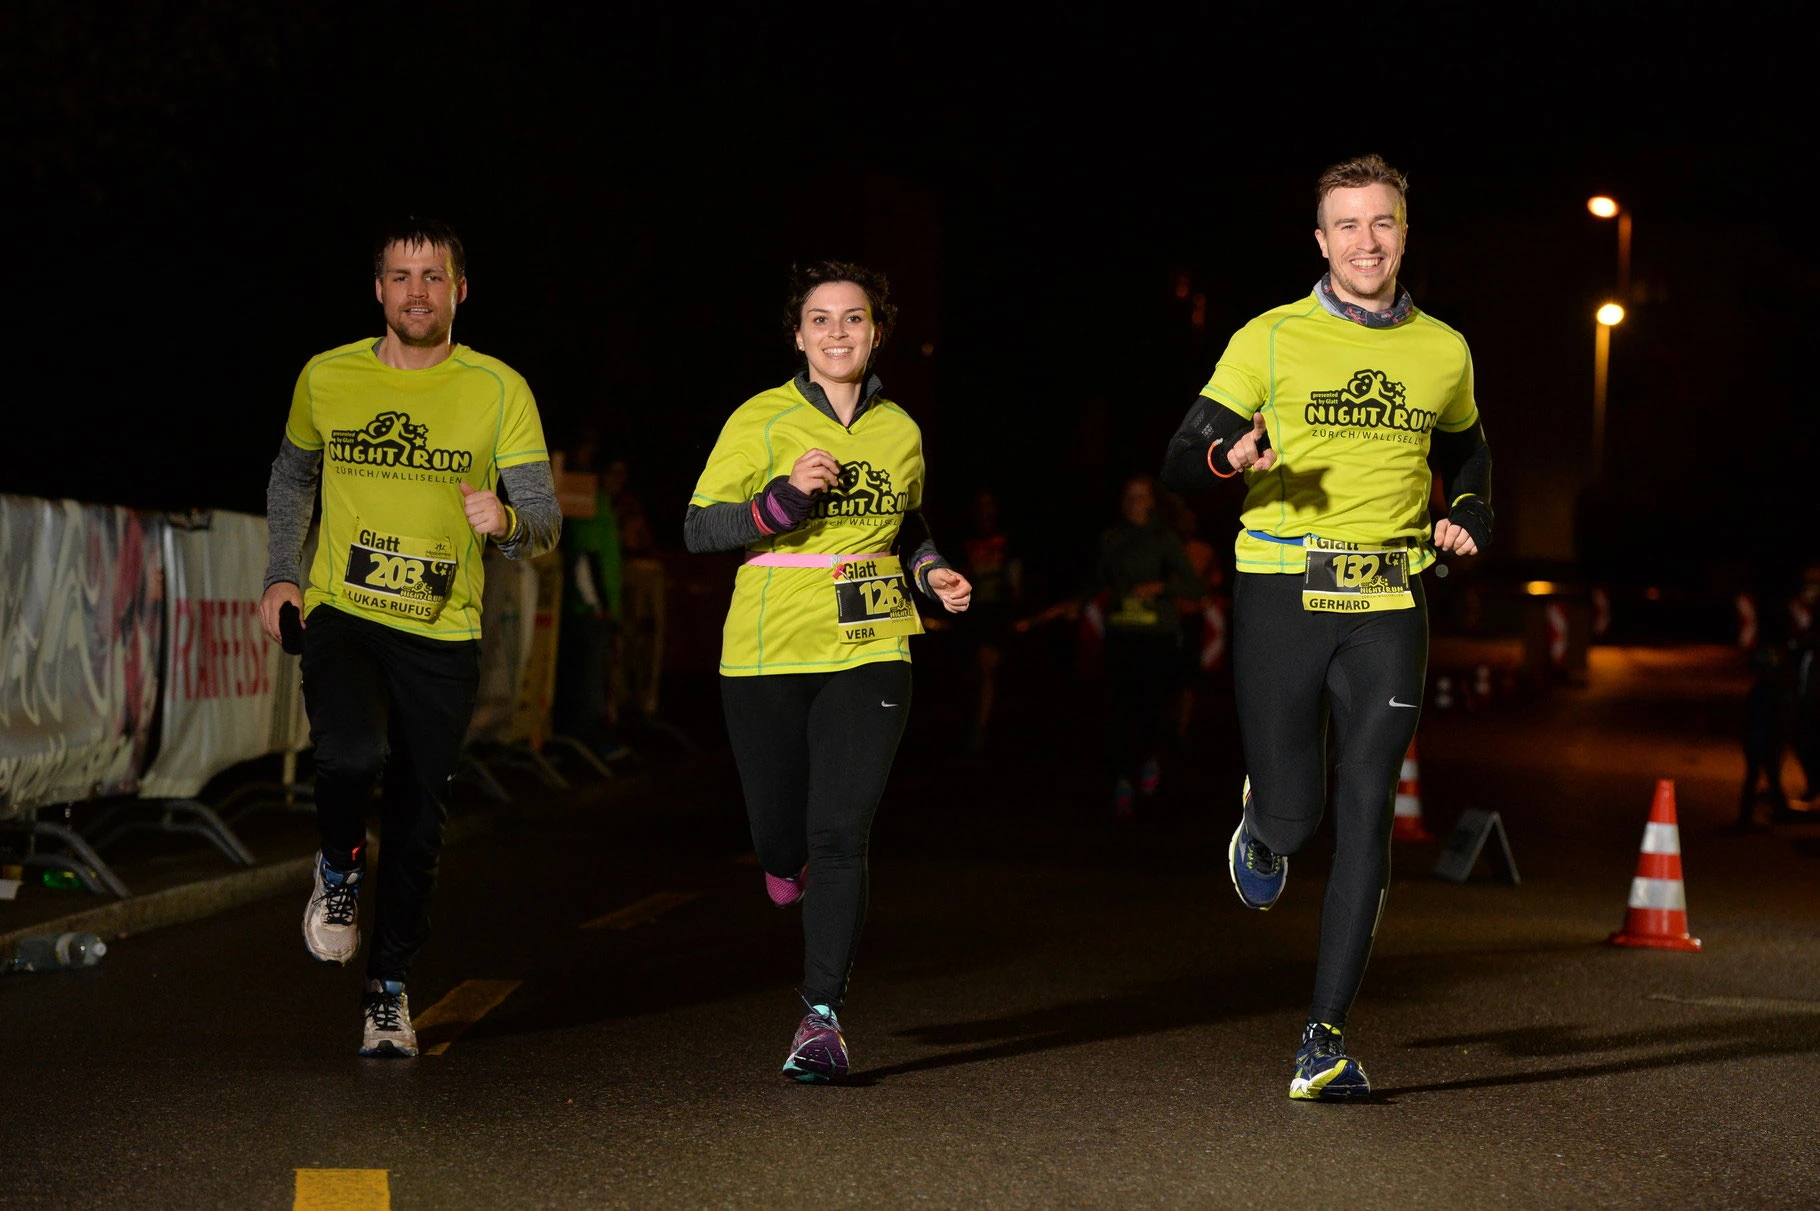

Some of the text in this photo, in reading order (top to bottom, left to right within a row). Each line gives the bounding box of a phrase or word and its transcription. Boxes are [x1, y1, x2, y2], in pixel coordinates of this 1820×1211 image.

[1305, 404, 1436, 433] NIGHT RUN
[329, 441, 472, 472] NIGHT RUN
[359, 529, 401, 553] Glatt
[365, 553, 425, 590] 203
[843, 560, 878, 580] Glatt
[1332, 554, 1380, 588] 132
[348, 590, 387, 609] LUKAS
[390, 601, 432, 617] RUFUS
[858, 578, 903, 616] 126
[1309, 598, 1370, 611] GERHARD
[845, 627, 875, 640] VERA
